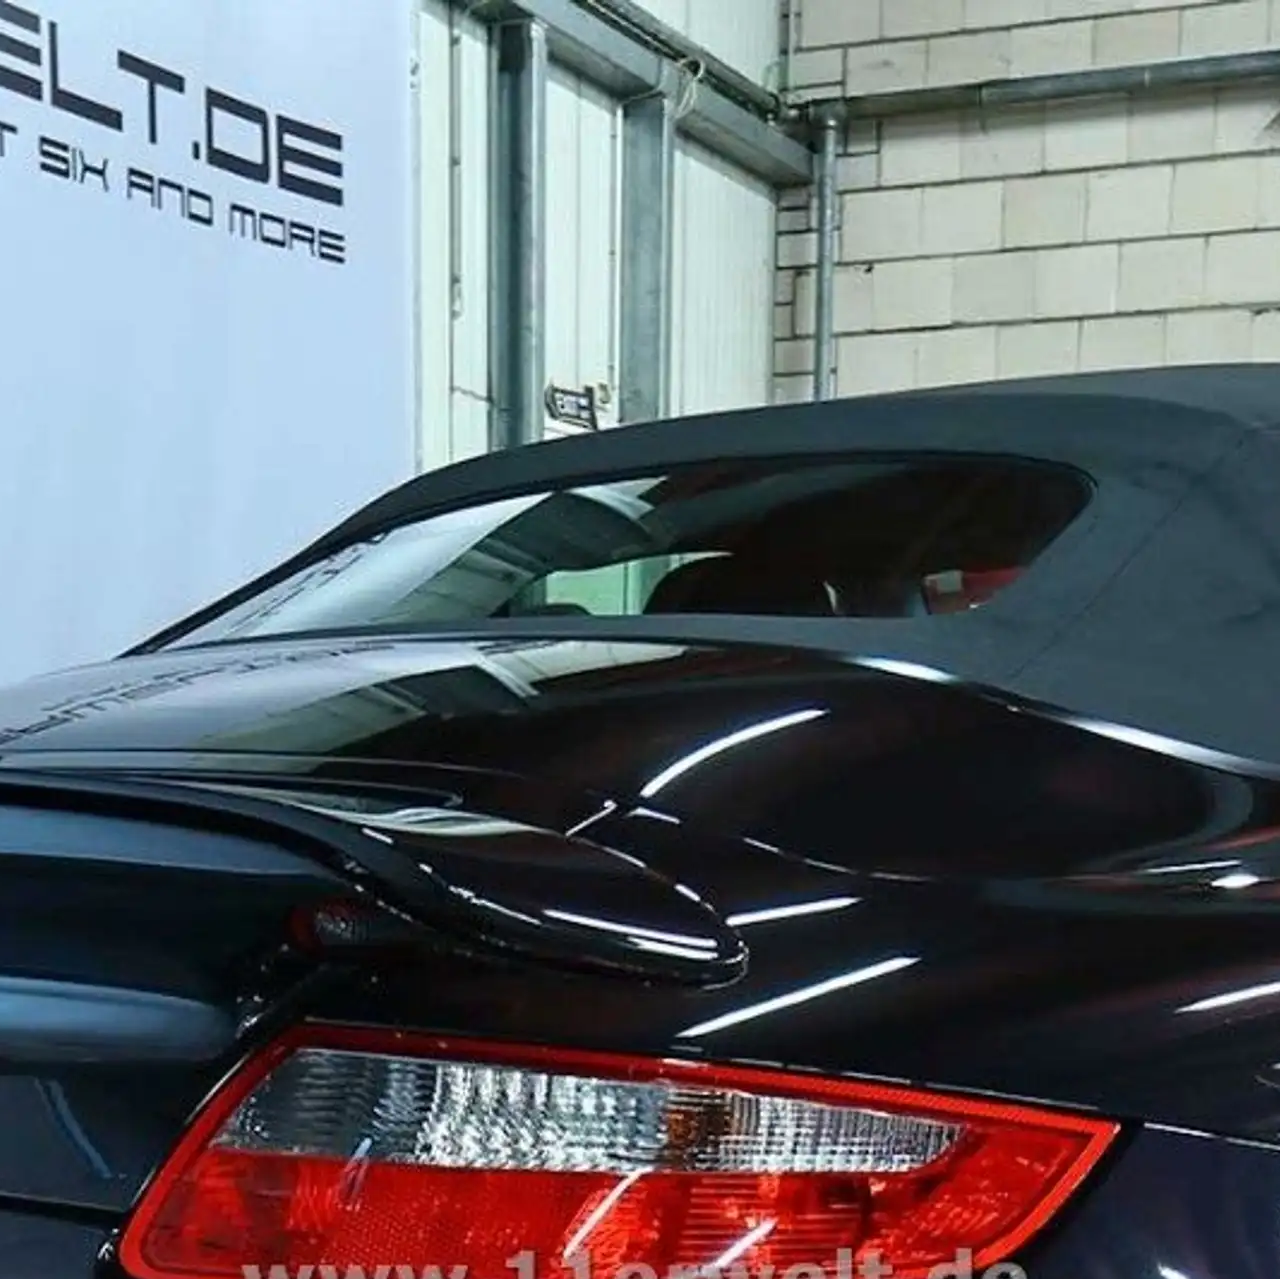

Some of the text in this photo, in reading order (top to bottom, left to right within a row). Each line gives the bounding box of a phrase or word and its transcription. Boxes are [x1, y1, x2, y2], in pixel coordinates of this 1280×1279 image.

[38, 135, 110, 192] SIX
[126, 167, 214, 226] AND
[228, 203, 346, 264] MORE
